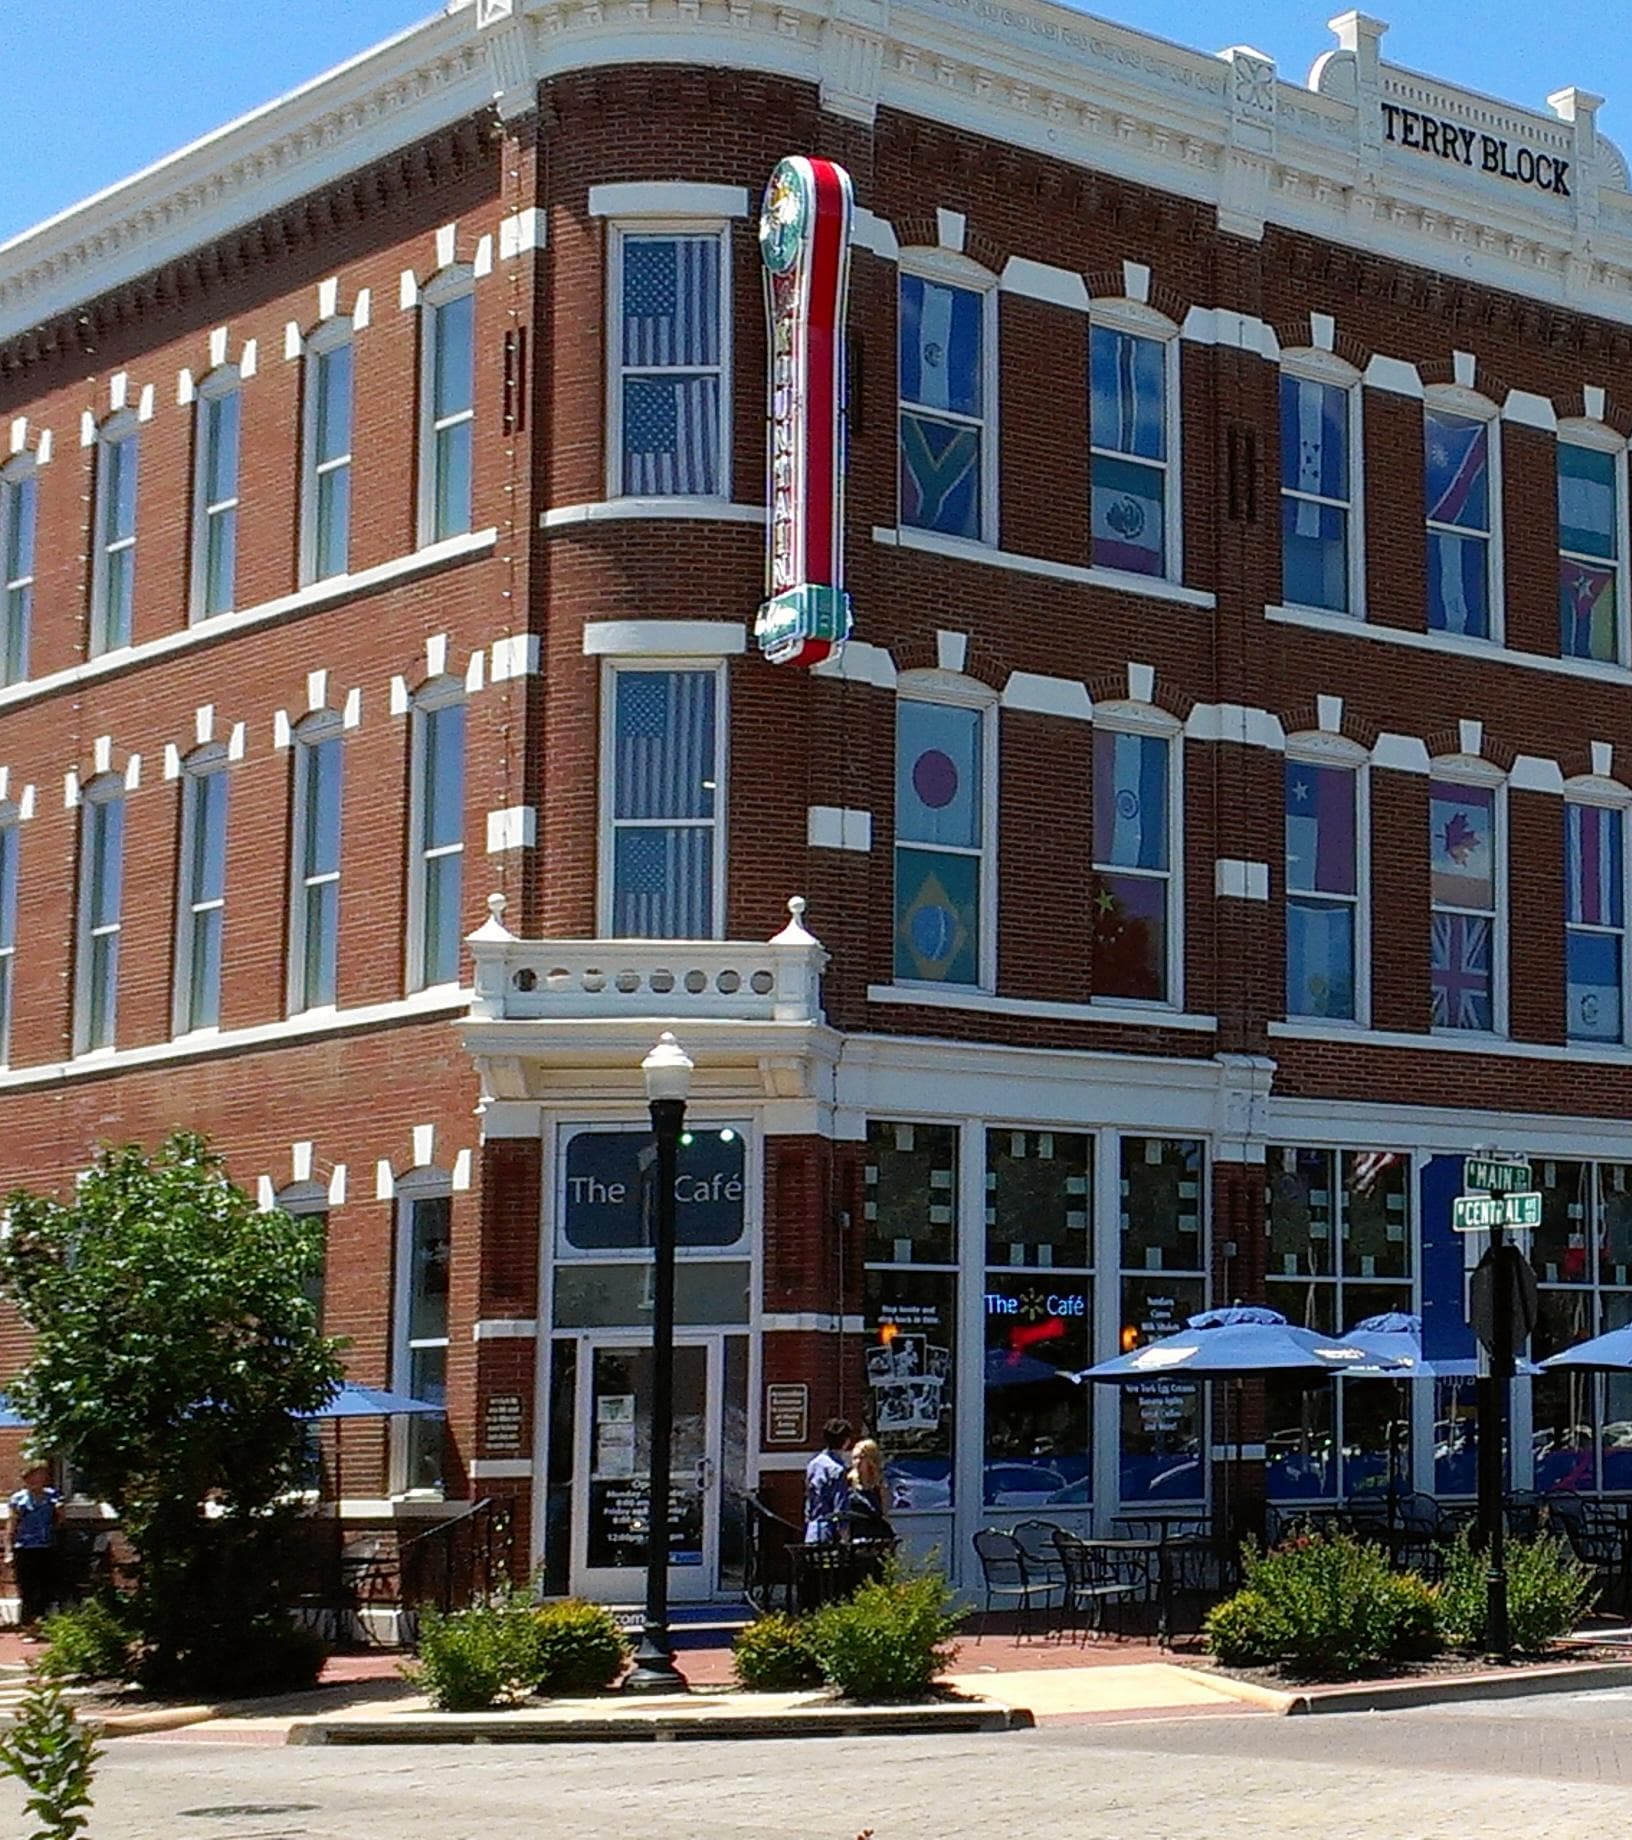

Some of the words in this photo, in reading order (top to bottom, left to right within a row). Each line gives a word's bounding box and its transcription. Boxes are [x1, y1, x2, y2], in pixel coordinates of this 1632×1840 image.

[1381, 102, 1476, 166] TERRY
[1480, 133, 1571, 197] BLOCK
[568, 1175, 626, 1204] The
[674, 1172, 742, 1203] Café
[1476, 1164, 1513, 1191] MAIN
[1466, 1199, 1522, 1225] CENTRAL
[984, 1294, 1019, 1315] The
[1046, 1293, 1085, 1317] Café
